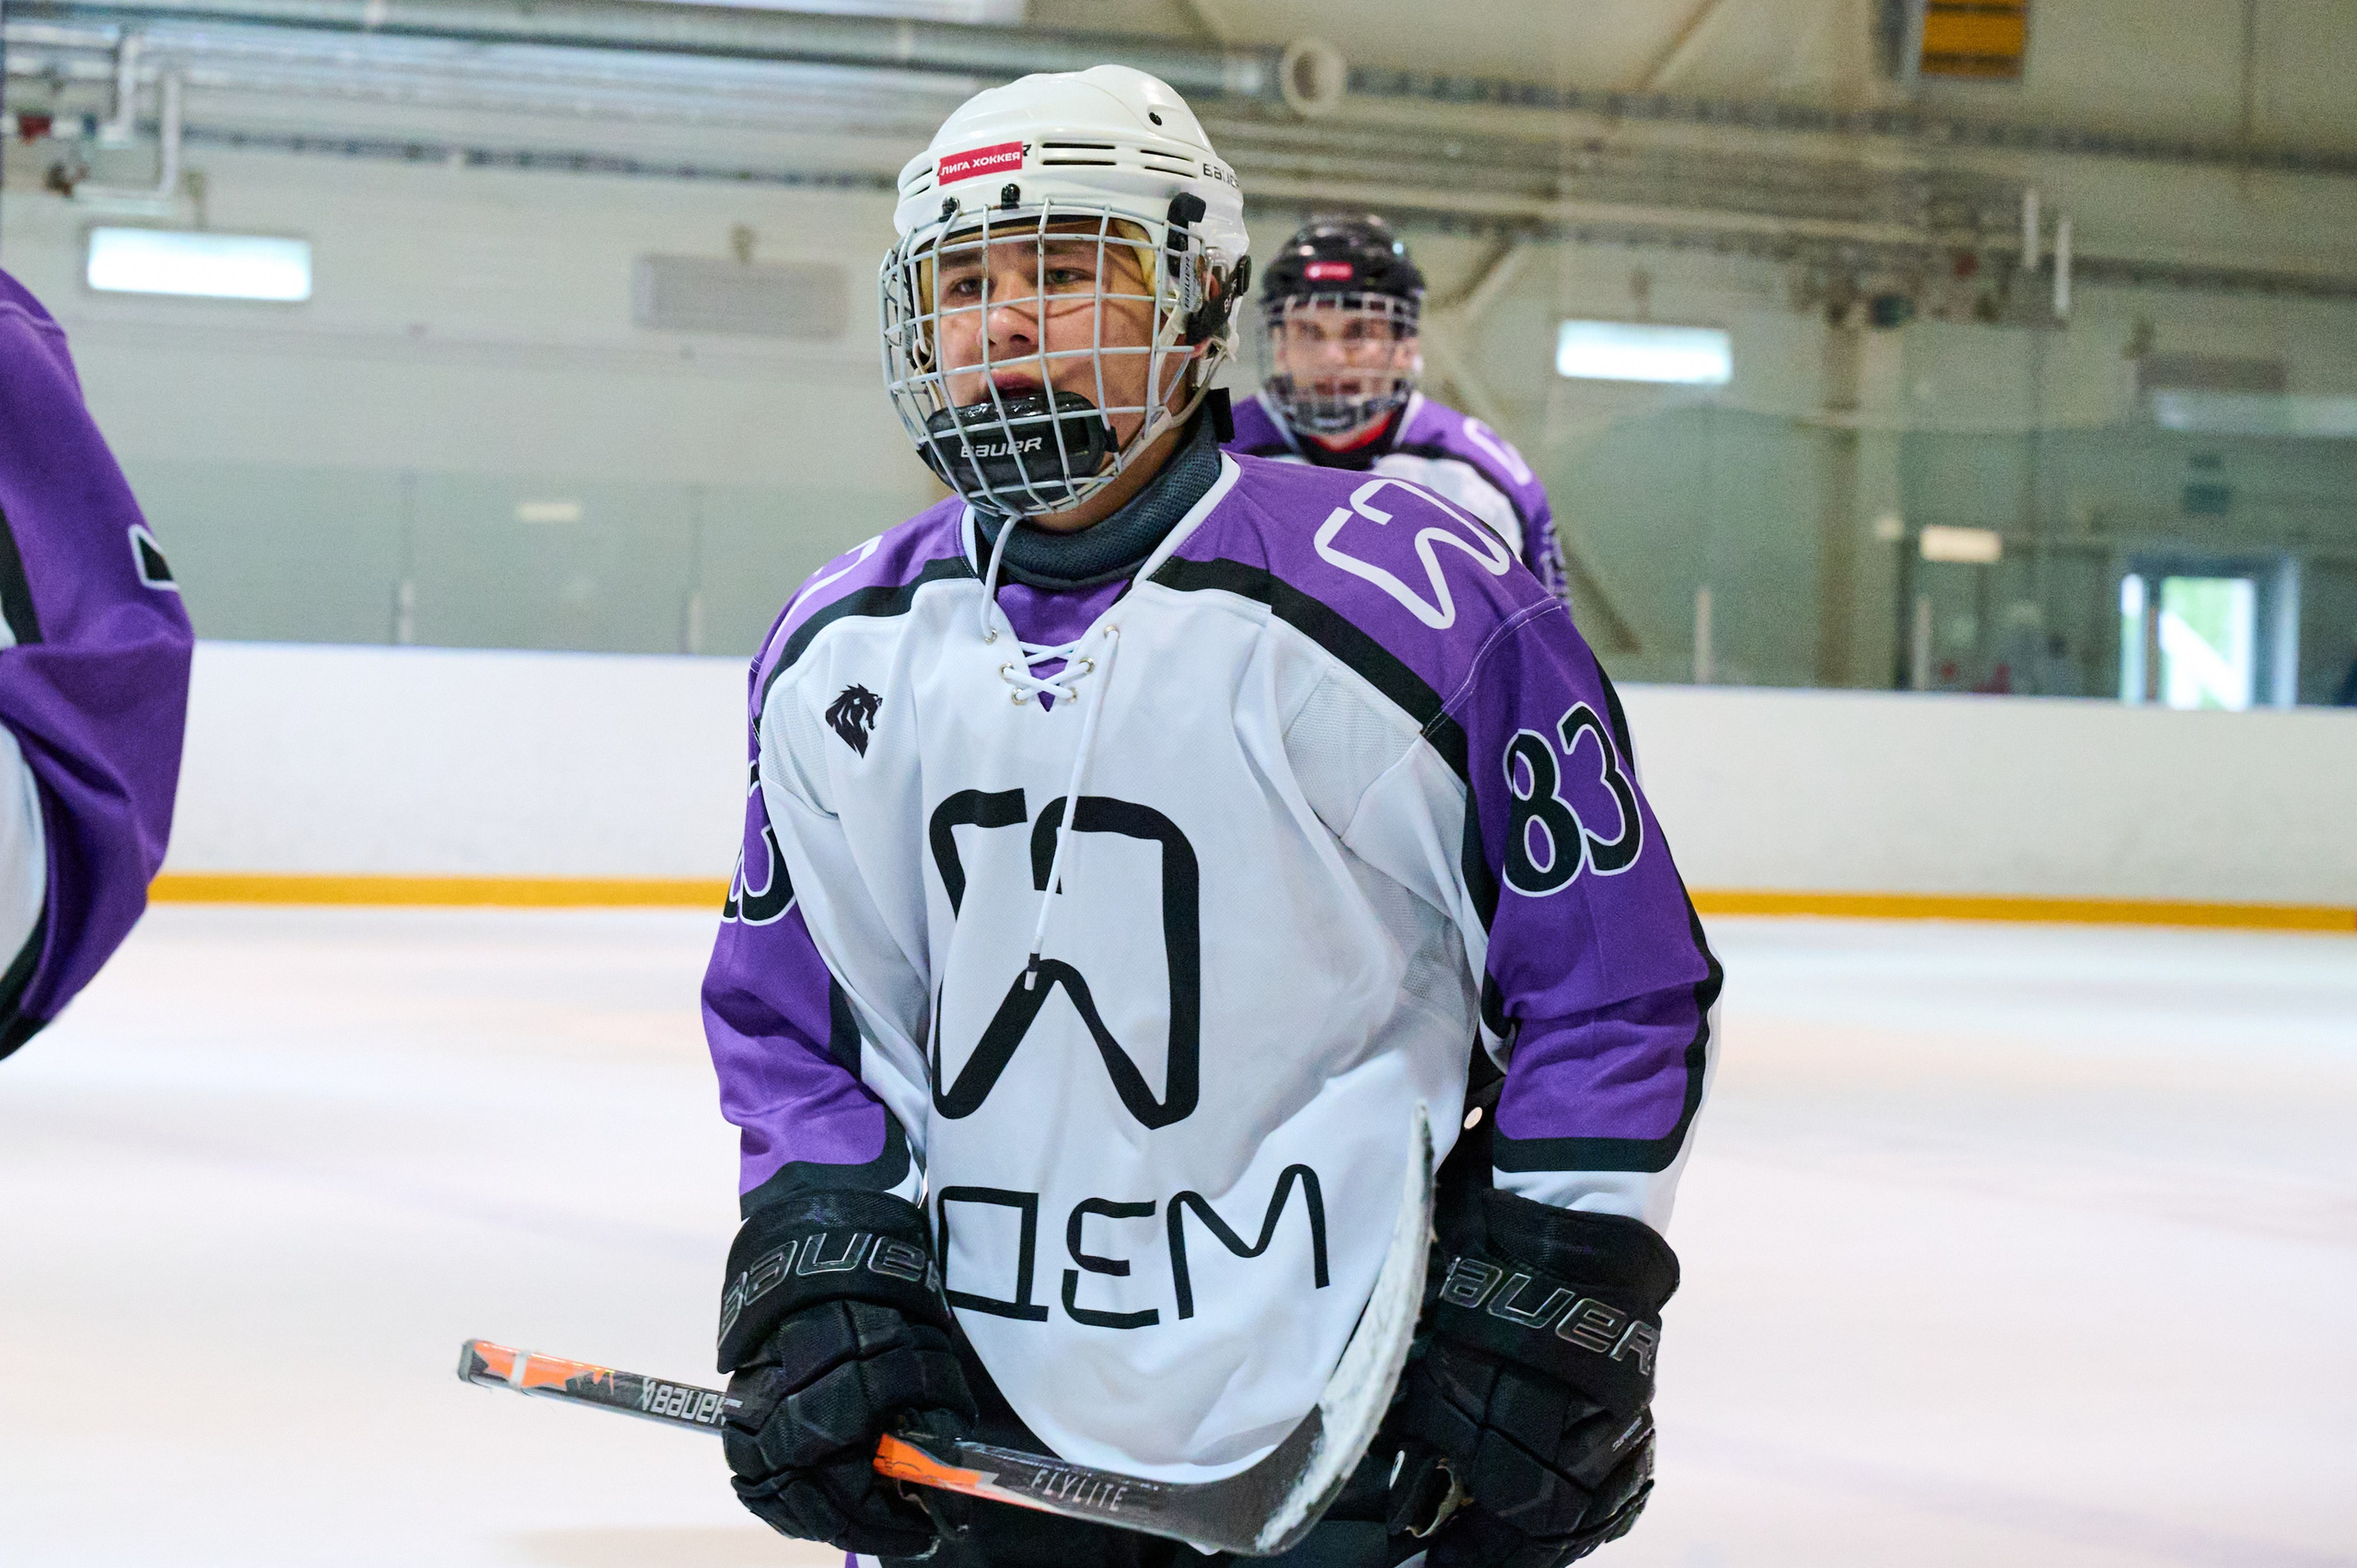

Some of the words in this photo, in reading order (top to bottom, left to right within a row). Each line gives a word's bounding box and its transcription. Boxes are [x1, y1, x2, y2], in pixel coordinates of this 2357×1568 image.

[940, 160, 971, 177] ЛИГА
[972, 151, 1021, 168] ХОККЕЯ
[1502, 700, 1644, 899] 83
